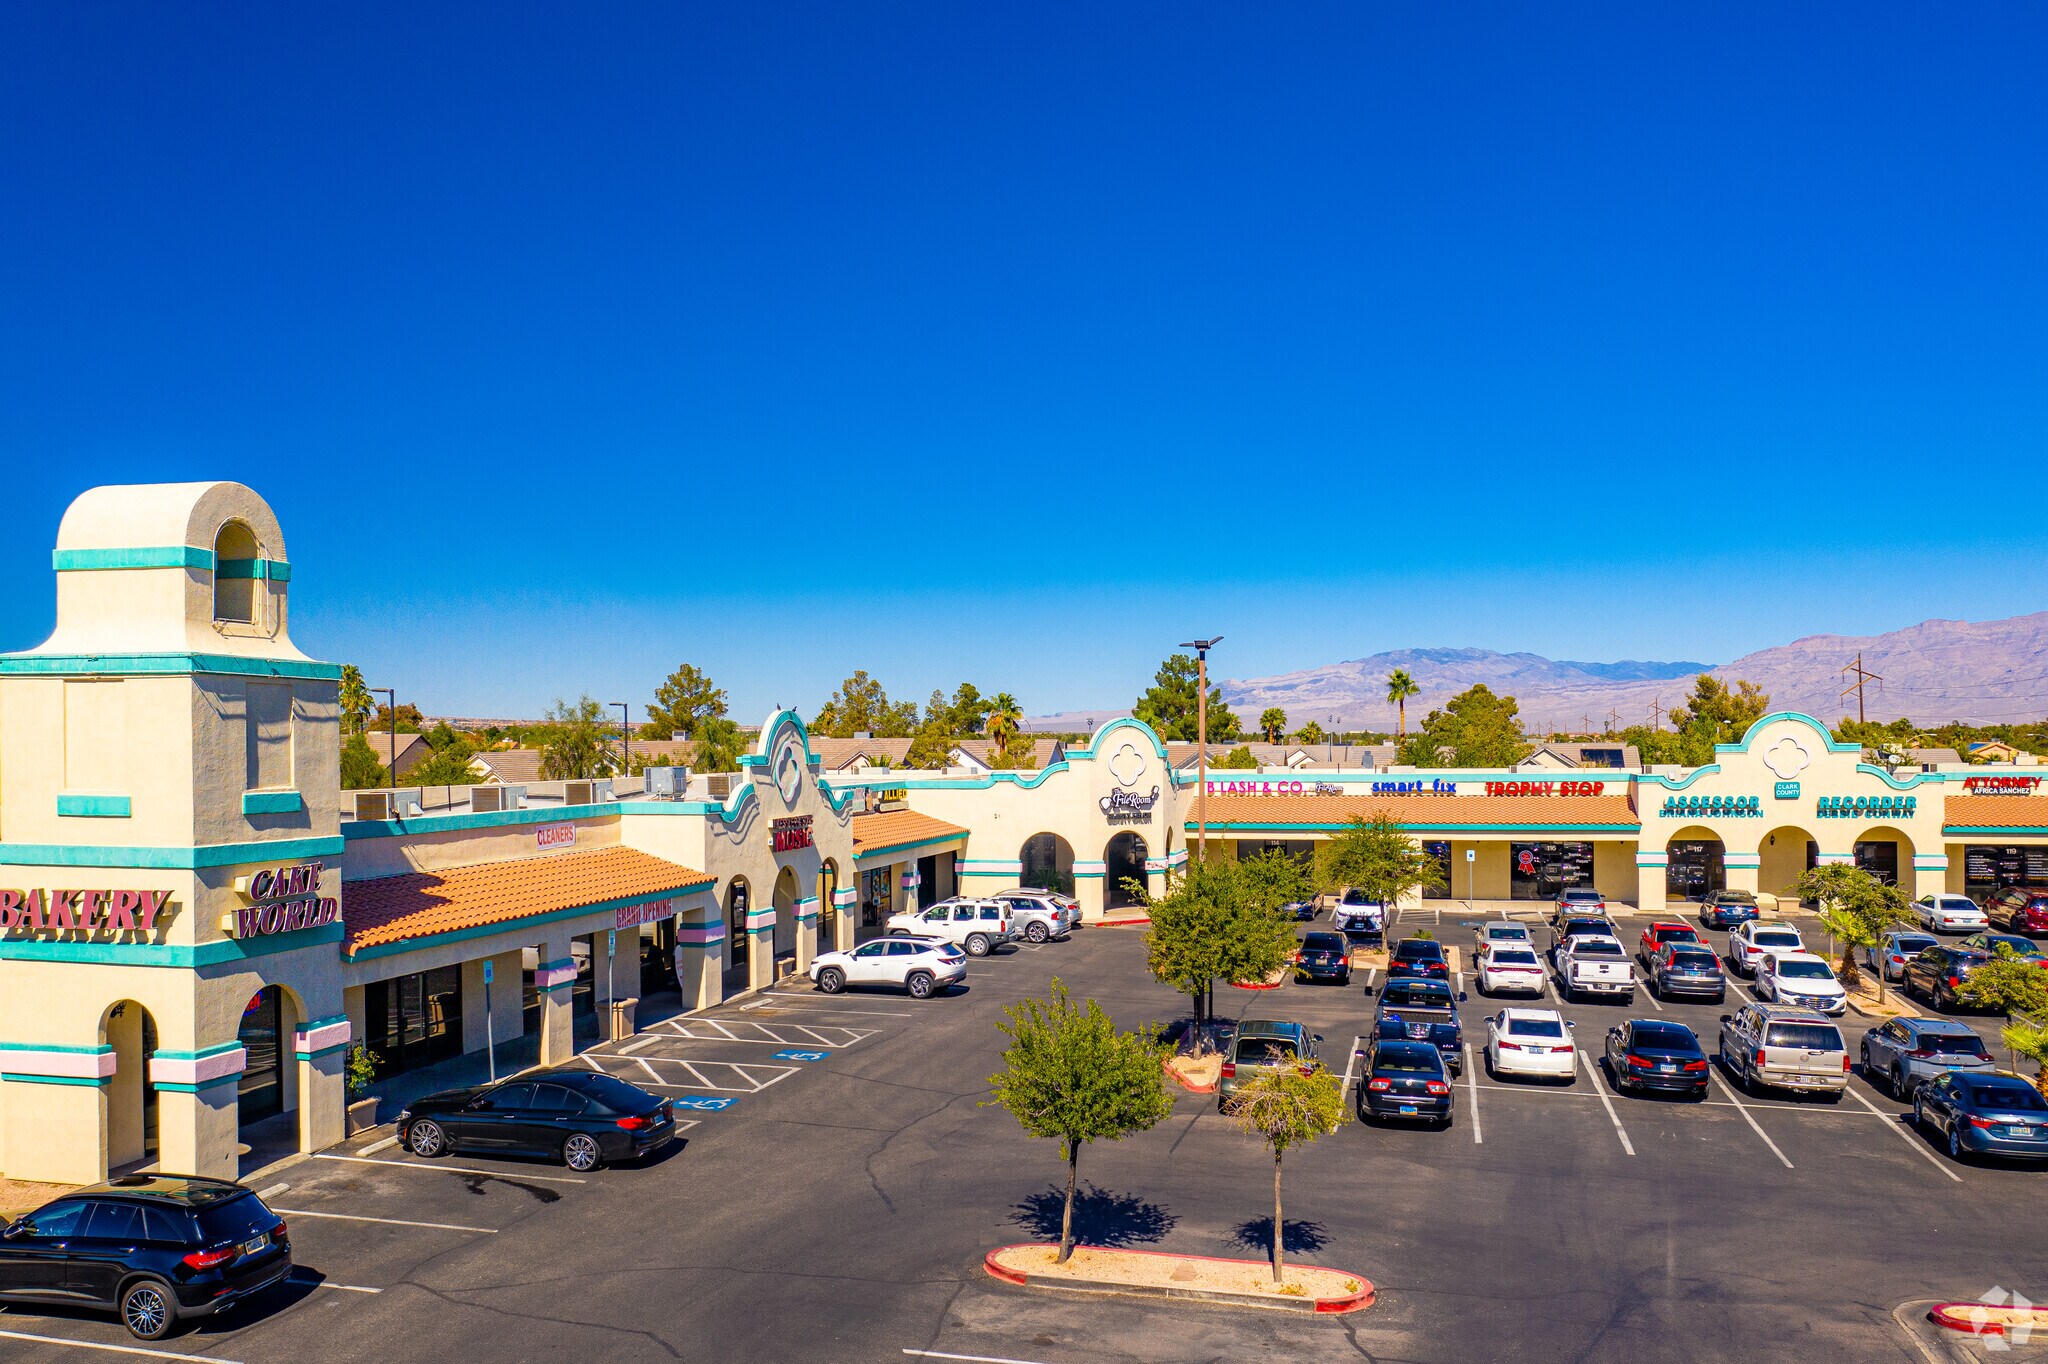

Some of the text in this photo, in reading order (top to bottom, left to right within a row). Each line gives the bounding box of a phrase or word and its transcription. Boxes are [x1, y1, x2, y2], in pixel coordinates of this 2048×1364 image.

[1207, 781, 1215, 793] B
[1220, 781, 1257, 793] LASH
[1262, 781, 1272, 793] &
[1372, 778, 1457, 793] smart fix
[1485, 781, 1605, 796] TROPHY STOP
[1963, 776, 2043, 789] ATTORNEY
[884, 788, 908, 801] ALLIED
[1974, 787, 1998, 795] AFRICA
[1665, 796, 1760, 809] ASSESSOR
[1818, 796, 1917, 809] RECORDER
[1659, 809, 1764, 818] BRIANA JOHNSON
[537, 825, 574, 846] CLEANERS
[774, 827, 814, 852] MUSIC
[249, 861, 324, 901] CAKE
[0, 889, 176, 931] BAKERY
[616, 898, 673, 929] GRAND OPENING
[232, 897, 338, 940] WORLD
